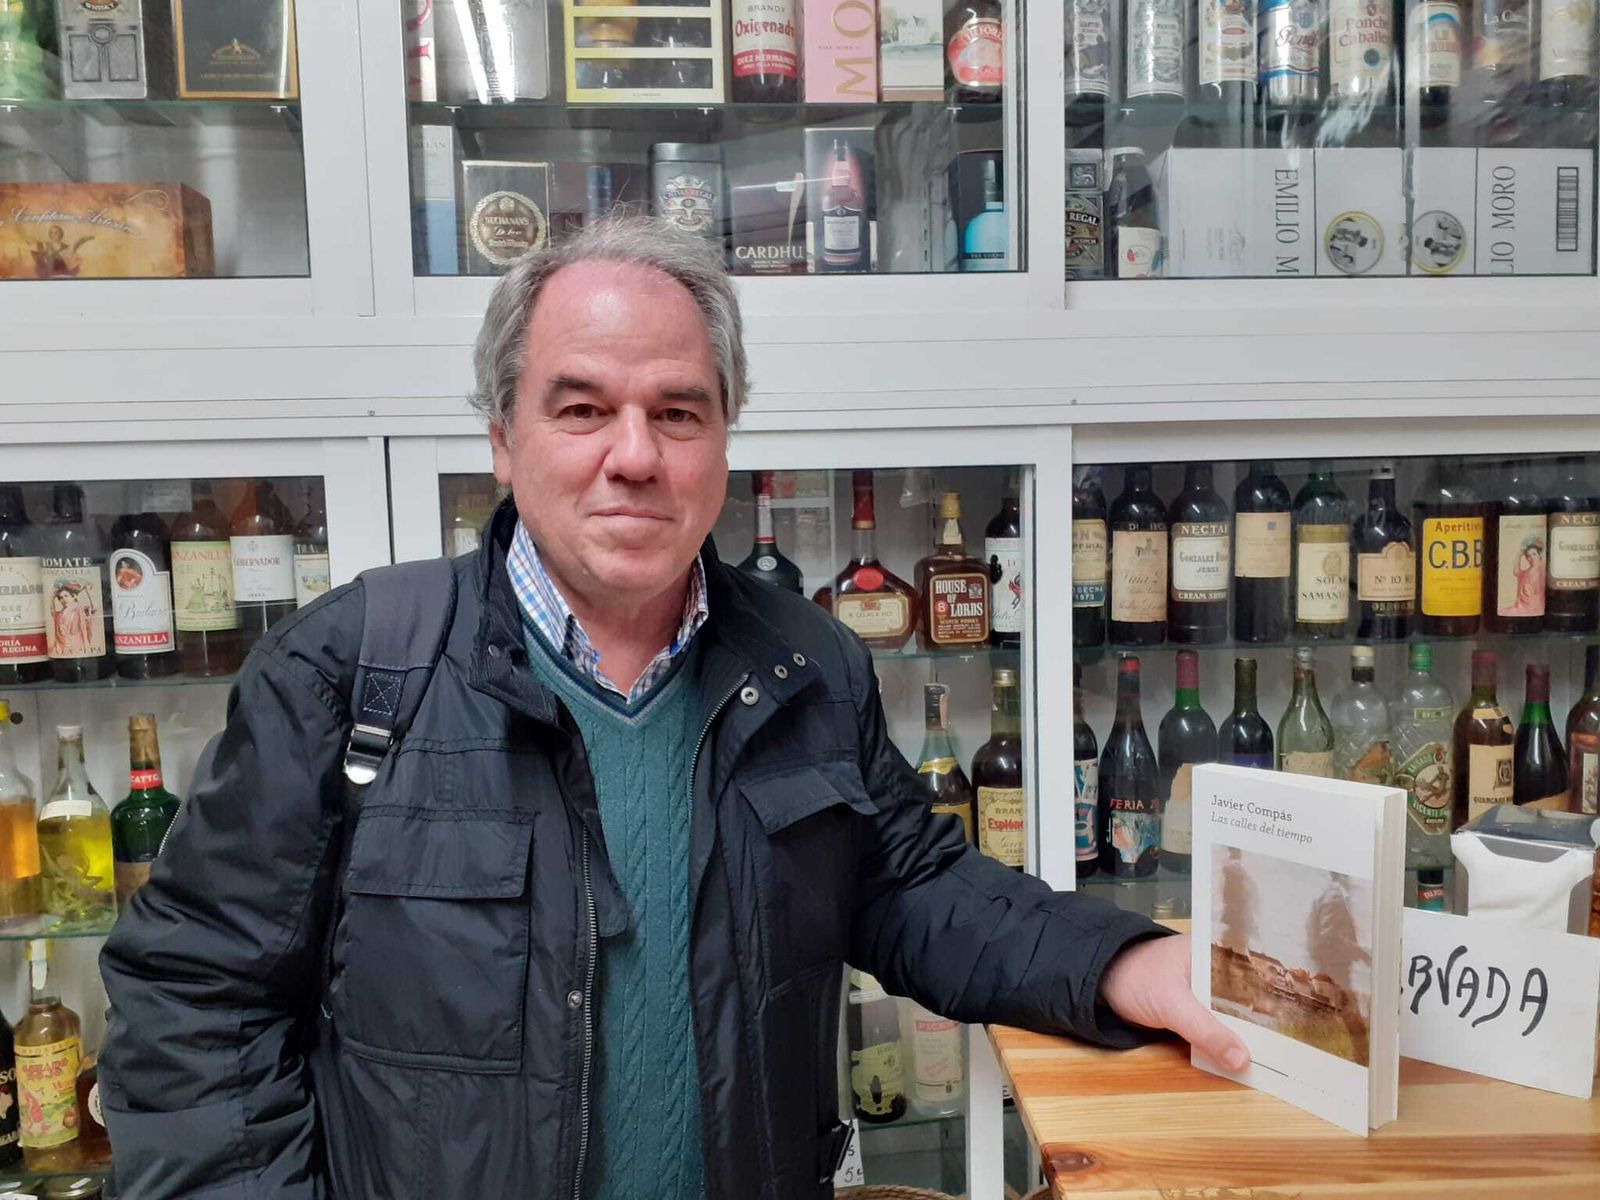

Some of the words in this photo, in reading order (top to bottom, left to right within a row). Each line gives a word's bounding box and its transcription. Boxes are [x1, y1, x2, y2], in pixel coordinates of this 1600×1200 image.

[1491, 165, 1516, 229] MORO
[1274, 169, 1300, 243] EMILIO
[1069, 212, 1098, 226] REGAL
[735, 245, 804, 259] CARDHU
[1275, 256, 1300, 273] M
[935, 579, 967, 594] HOUSE
[946, 594, 957, 604] OF
[1178, 592, 1207, 601] CREAM
[950, 602, 983, 617] LORDS
[2, 645, 37, 654] REGINA
[1109, 798, 1145, 810] FERIA
[1210, 794, 1244, 813] Javier
[1246, 802, 1293, 823] Compás
[1210, 811, 1229, 824] Las
[1230, 815, 1258, 832] calles
[1258, 822, 1276, 836] del
[1276, 828, 1313, 845] tiempo
[1400, 945, 1549, 1037] RVADA
